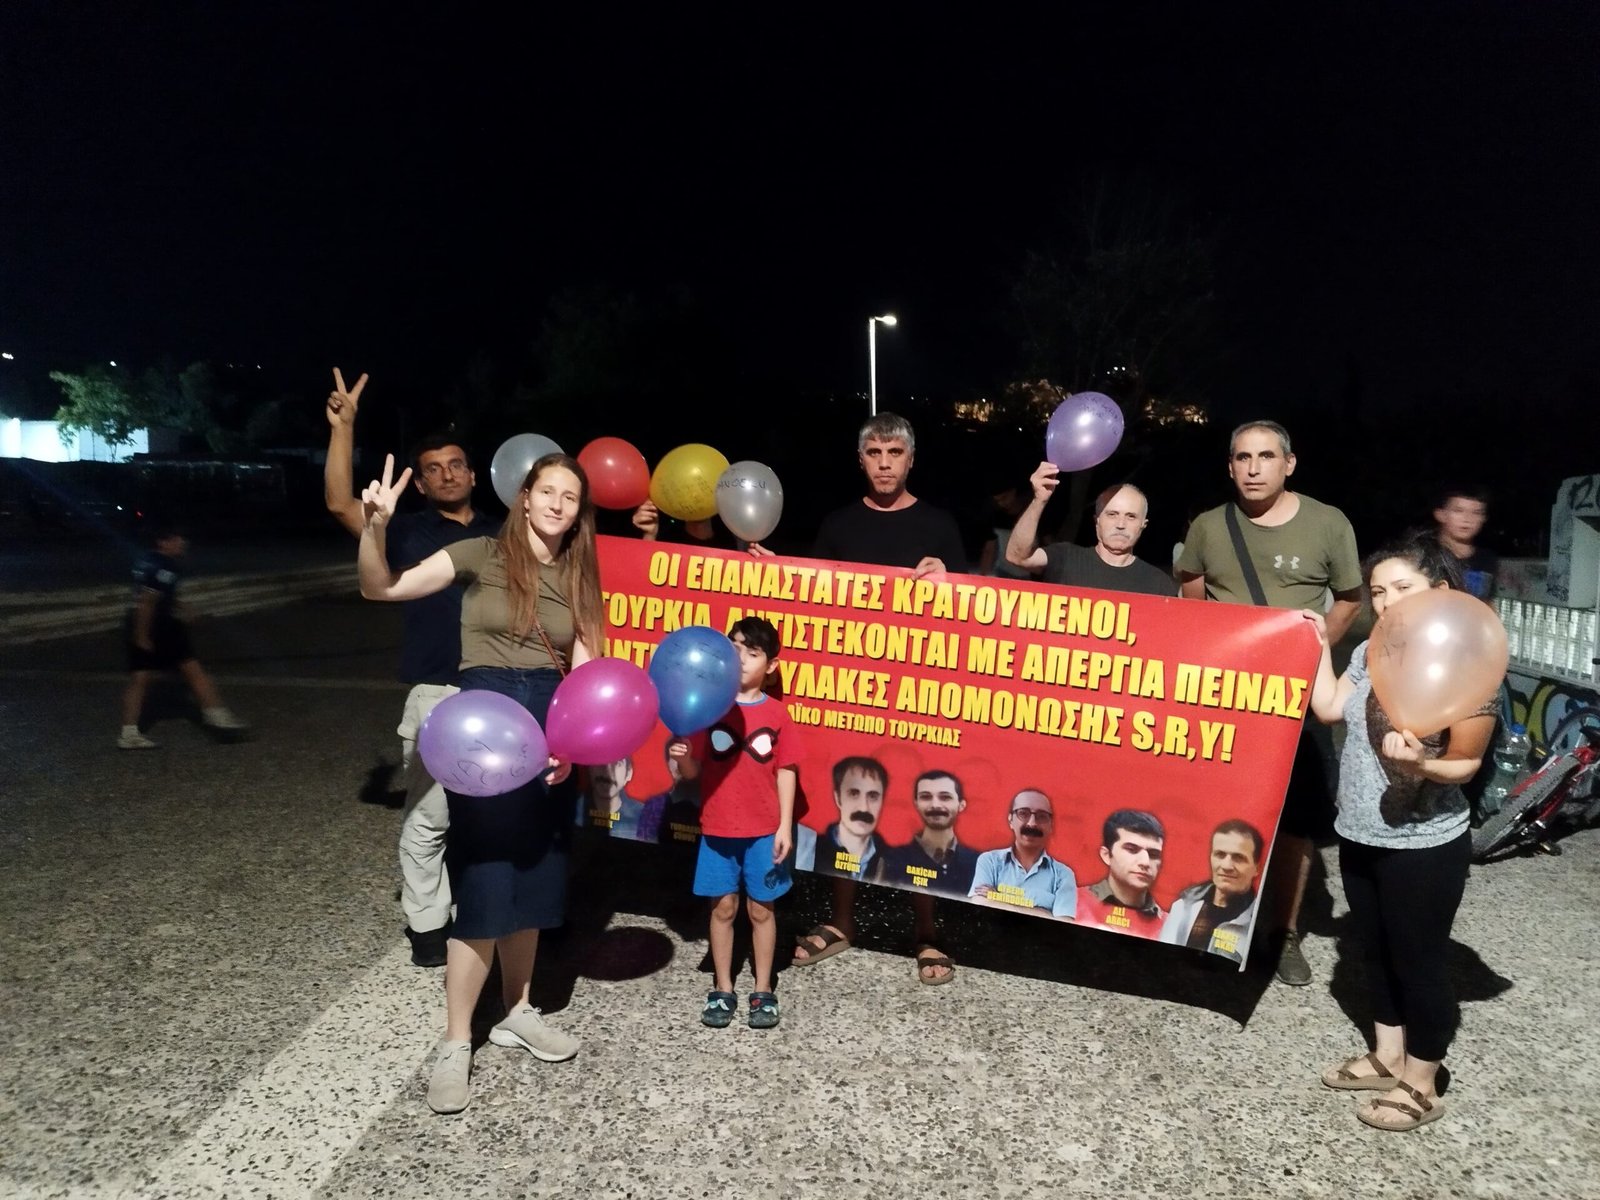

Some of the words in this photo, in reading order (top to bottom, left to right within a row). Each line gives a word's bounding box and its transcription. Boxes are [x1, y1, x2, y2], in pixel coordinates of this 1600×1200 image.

[649, 551, 680, 587] ΟΙ
[686, 555, 886, 611] ΕΠΑΝΑΣΤΑΤΕΣ
[892, 577, 1137, 646] ΚΡΑΤΟΥΜΕΝΟΙ,
[779, 659, 891, 709] ΥΛΑΚΕΣ
[896, 681, 1125, 746] ΑΠΟΜΟΝΩΣΗΣ
[967, 635, 1017, 679] ΜΕ
[1021, 643, 1166, 700] ΑΠΕΡΓΙΑ
[1174, 662, 1308, 720] ΠΕΙΝΑΣ
[823, 710, 886, 736] ΜΕΤΩΠΟ
[889, 720, 962, 748] ΤΟΥΡΚΙΑΣ
